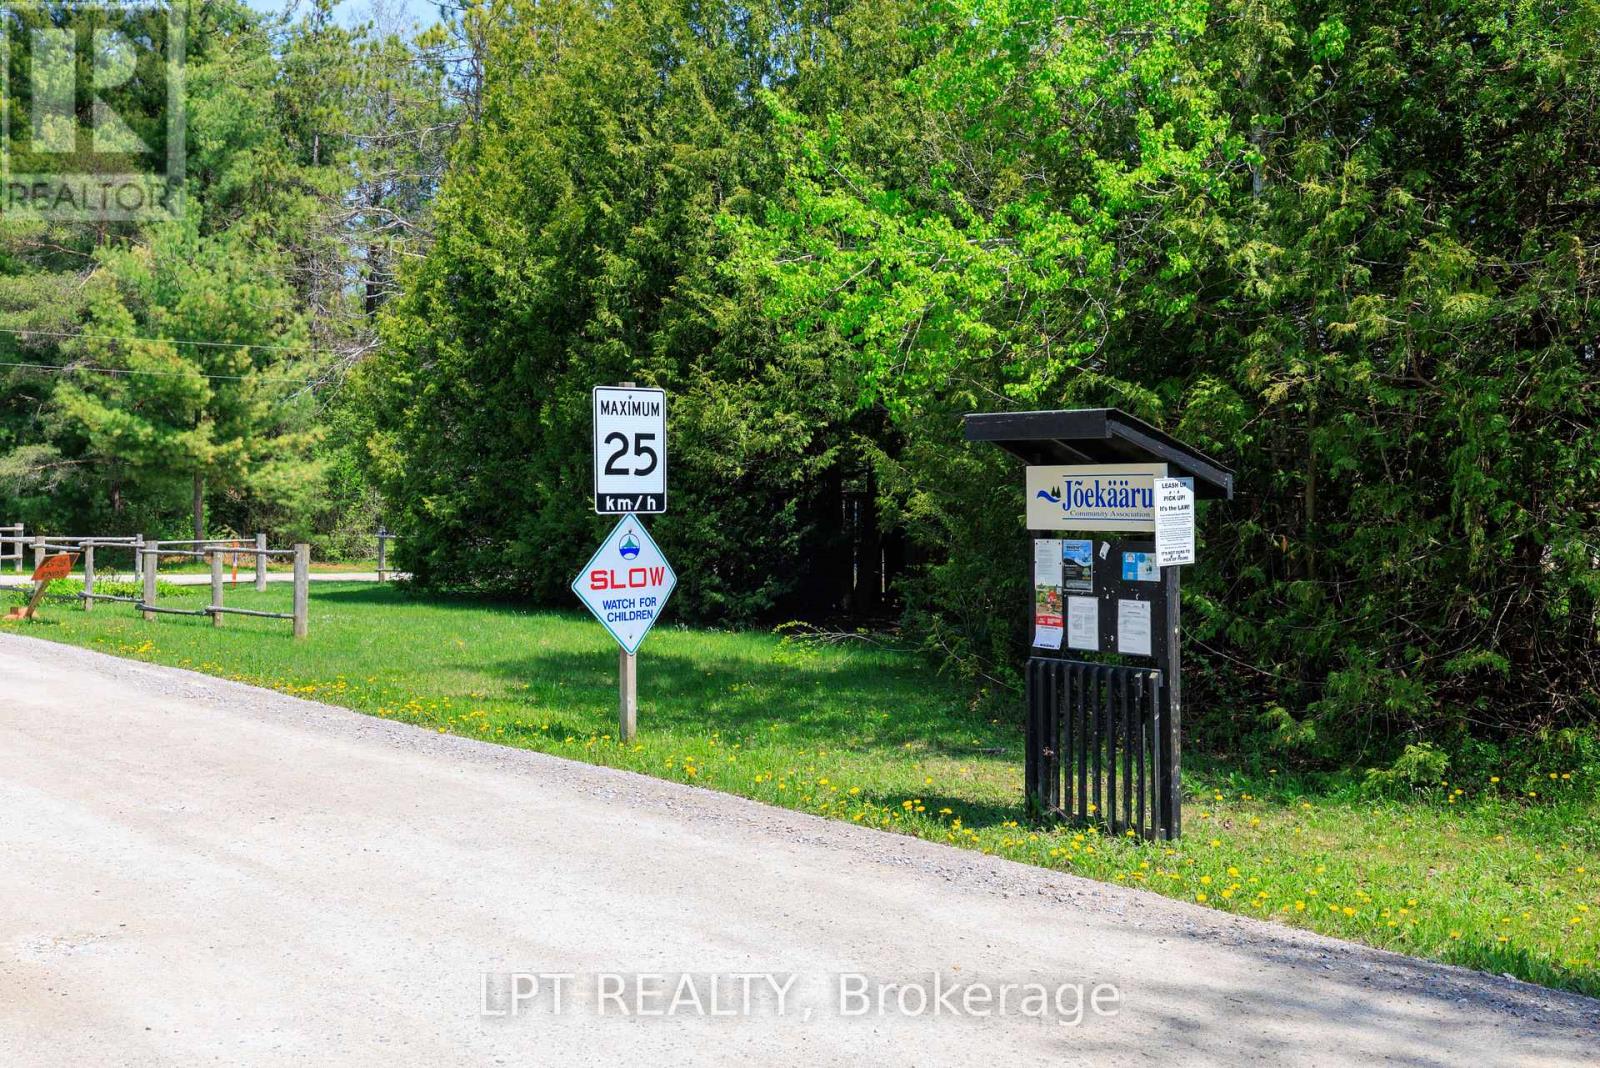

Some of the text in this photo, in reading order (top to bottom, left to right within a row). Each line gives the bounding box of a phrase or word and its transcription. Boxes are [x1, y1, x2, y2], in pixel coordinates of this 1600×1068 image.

[600, 399, 660, 417] MAXIMUM
[604, 431, 658, 477] 25
[605, 494, 657, 511] km/h
[1062, 480, 1153, 511] Jõekääru
[1069, 510, 1151, 518] Community Association
[590, 566, 665, 590] SLOW
[602, 596, 657, 610] WATCH FOR
[607, 609, 653, 623] CHILDREN
